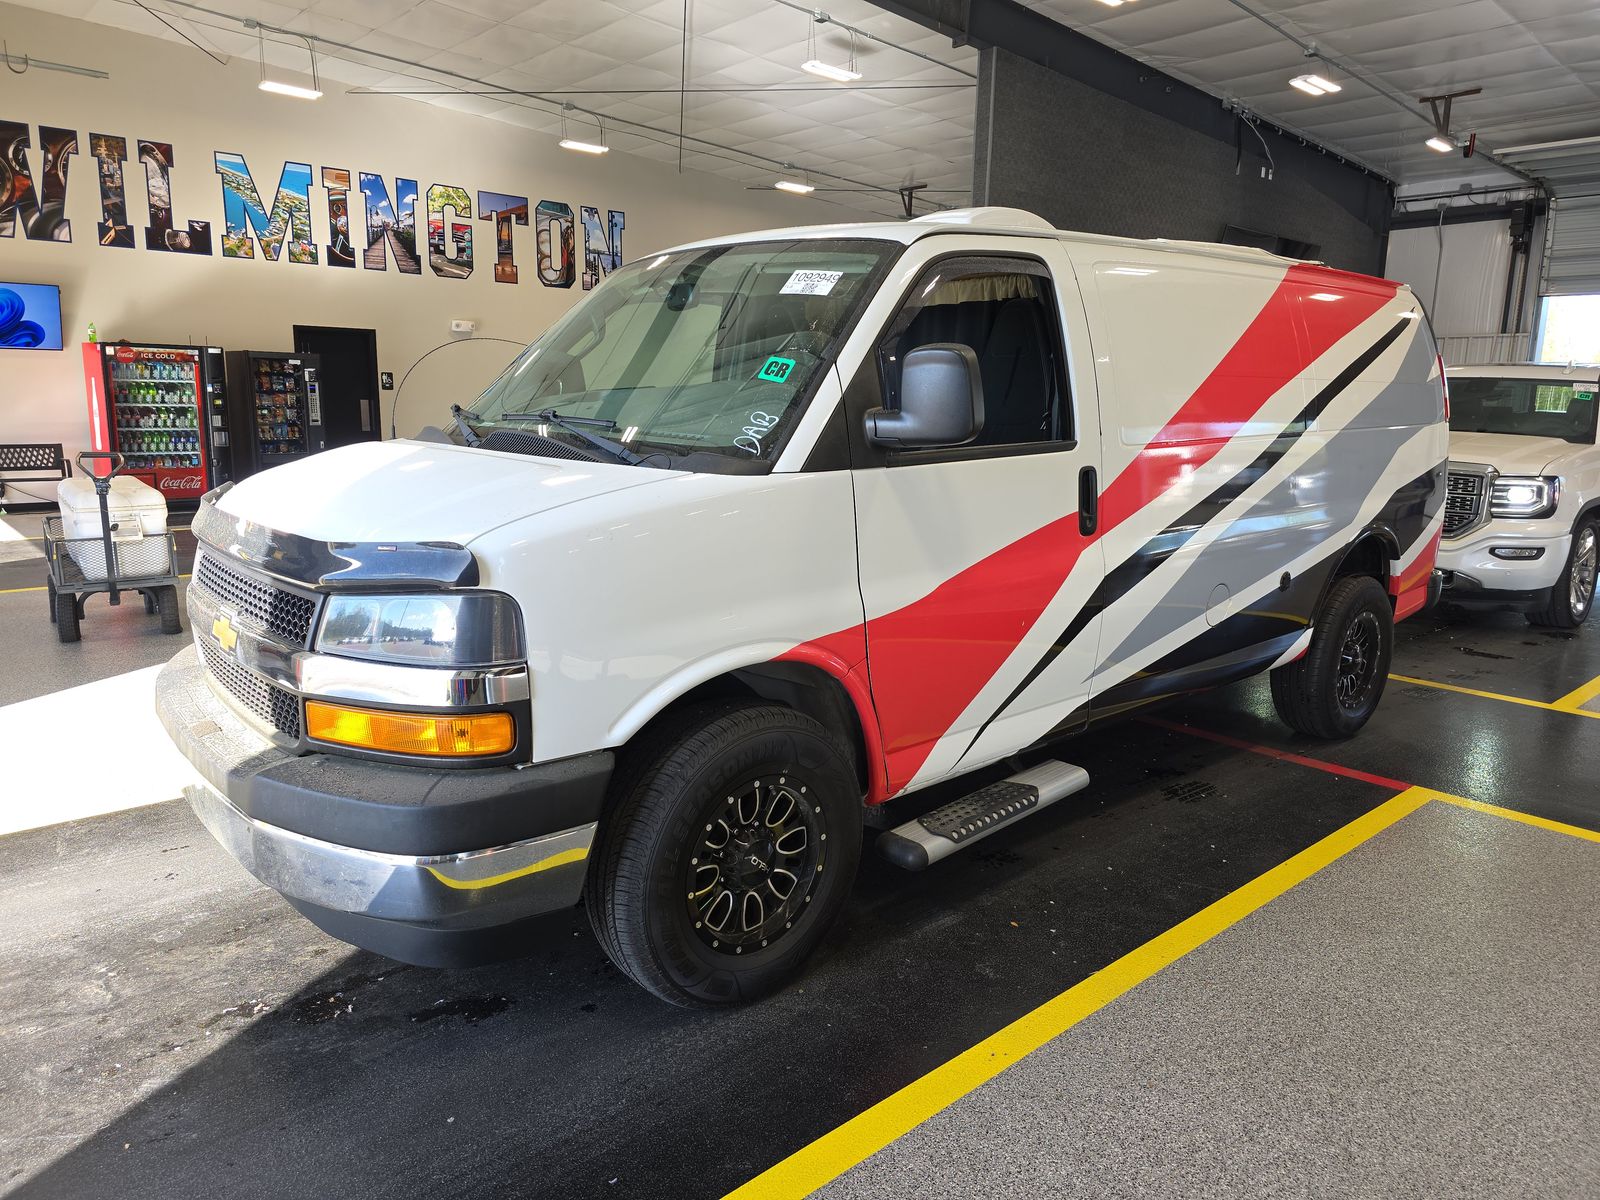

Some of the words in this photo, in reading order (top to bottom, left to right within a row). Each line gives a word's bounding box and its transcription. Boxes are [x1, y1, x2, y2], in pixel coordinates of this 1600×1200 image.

[0, 120, 625, 291] WILMINGTON
[792, 272, 841, 284] 1092949
[764, 360, 791, 379] CR
[160, 475, 202, 490] Coca-Cola
